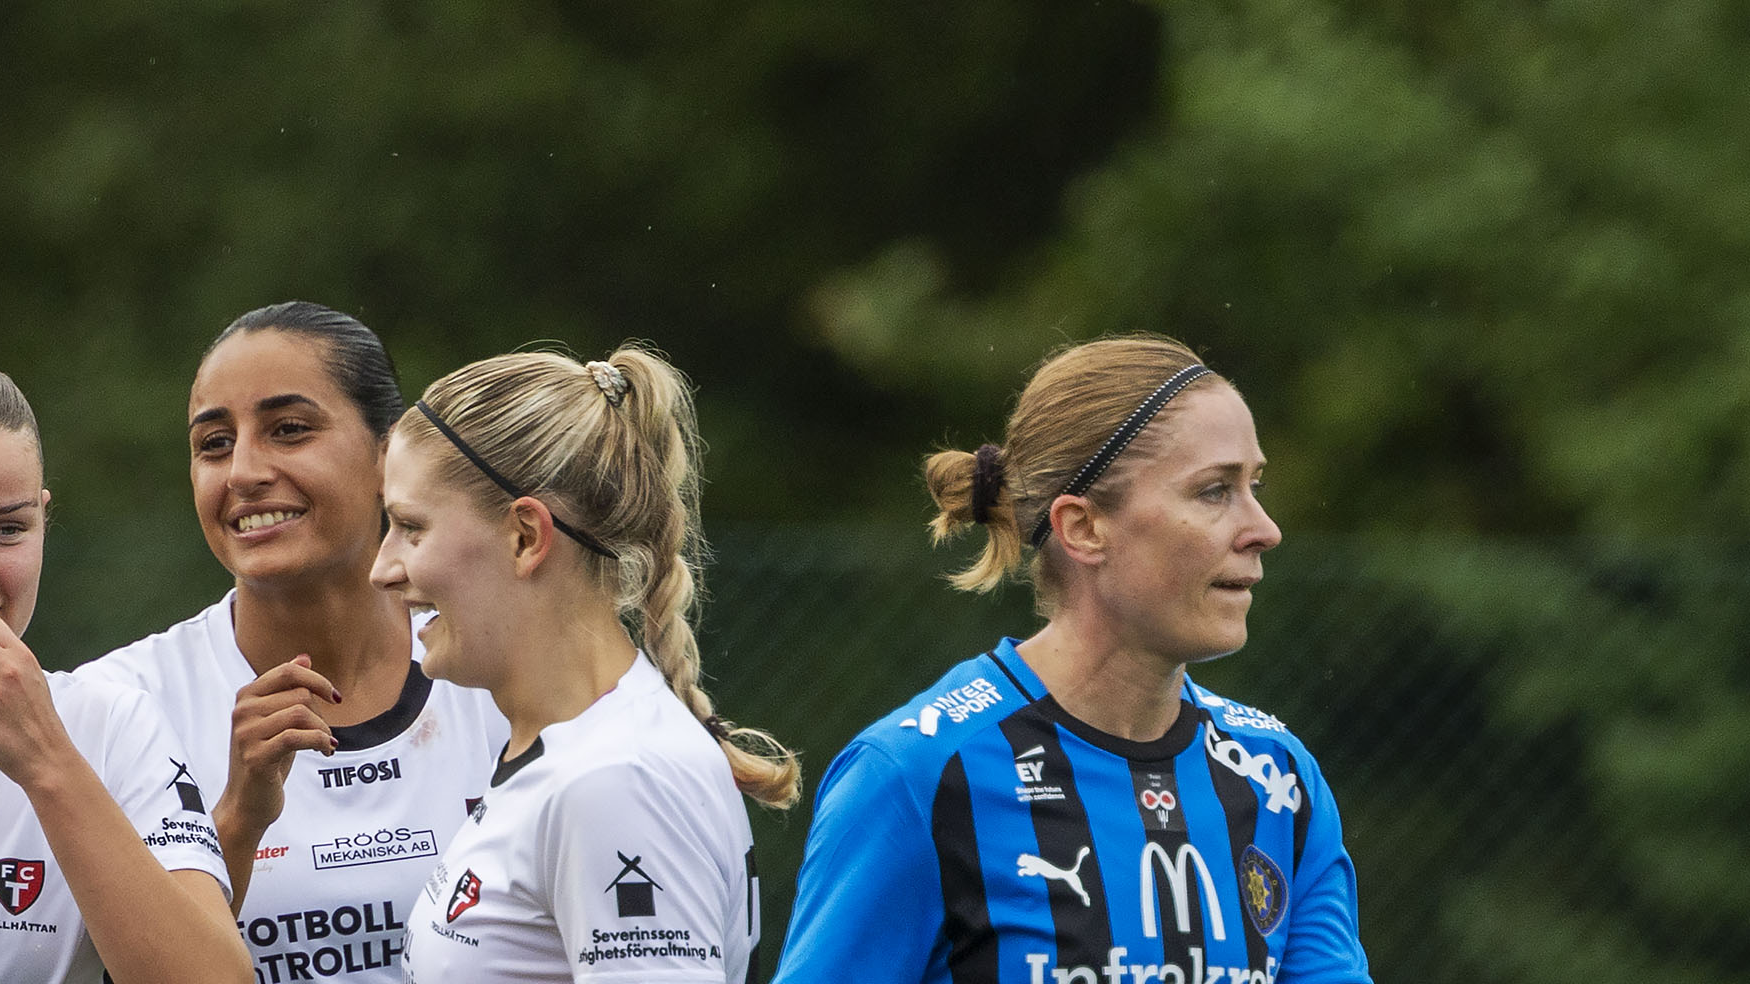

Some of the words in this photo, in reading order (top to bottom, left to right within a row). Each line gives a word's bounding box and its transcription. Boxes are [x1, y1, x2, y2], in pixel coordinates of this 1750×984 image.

[946, 685, 1003, 723] SPORT
[318, 758, 402, 790] TIFOSI
[1015, 760, 1044, 782] EY
[334, 827, 412, 850] RÖÖS
[319, 842, 407, 866] MEKANISKA
[410, 839, 432, 854] AB
[592, 926, 691, 944] Severinssons
